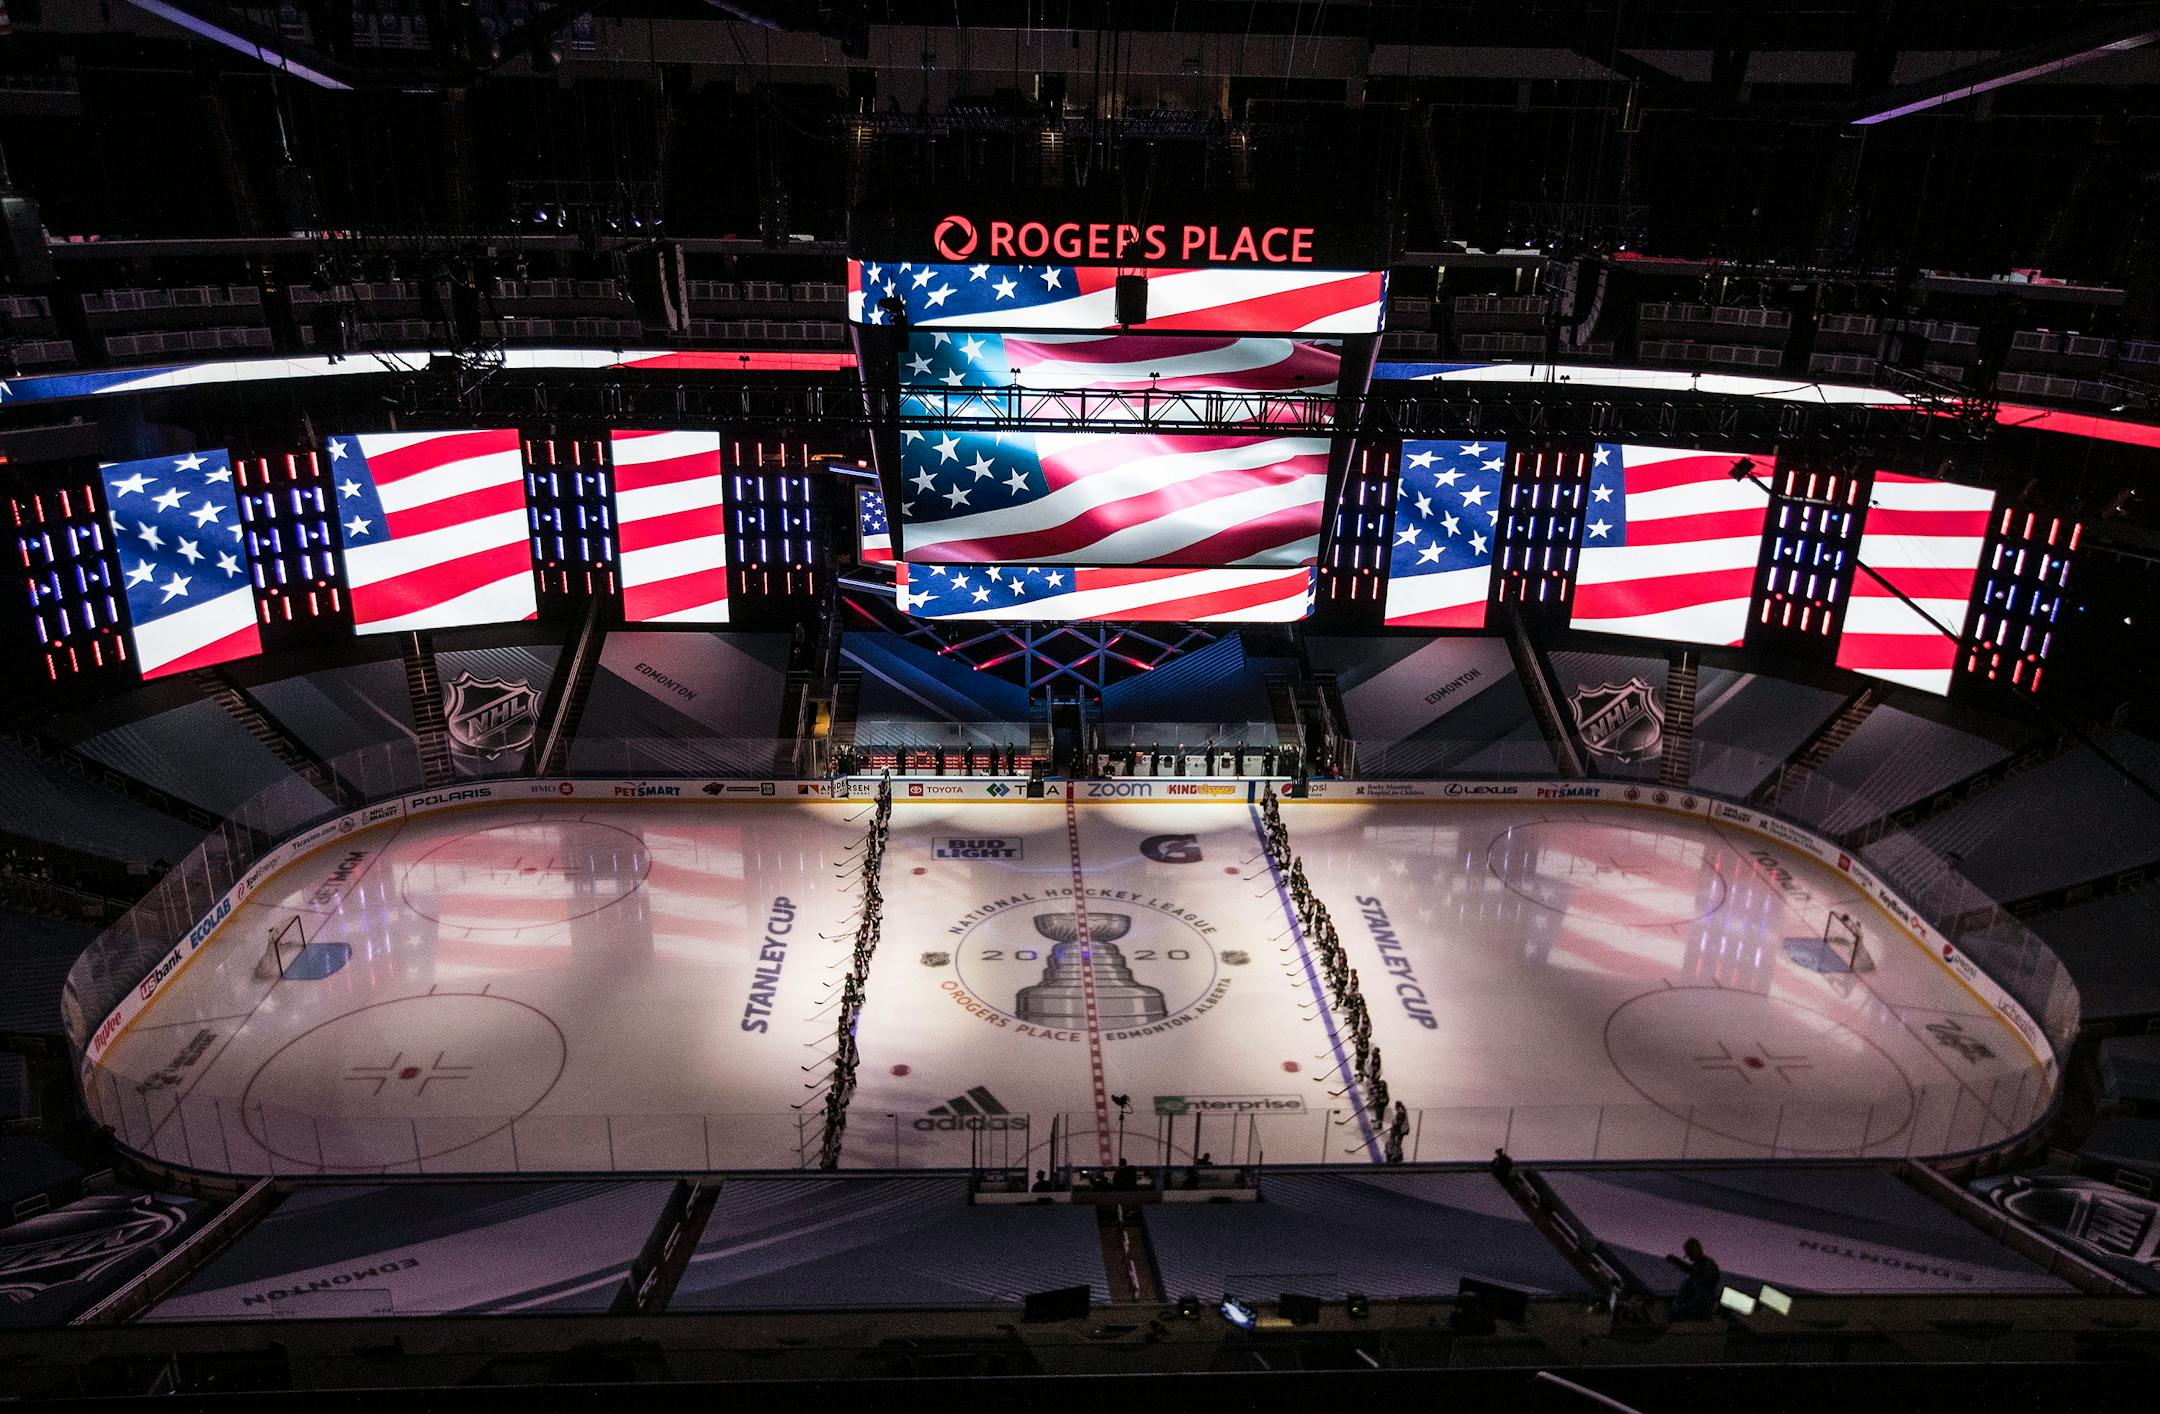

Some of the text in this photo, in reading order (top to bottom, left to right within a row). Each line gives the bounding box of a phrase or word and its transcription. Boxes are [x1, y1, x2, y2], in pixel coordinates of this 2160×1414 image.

[991, 222, 1315, 262] ROGERS PLACE
[634, 662, 697, 701] EDMONTON
[1424, 668, 1482, 705] EDMONTON
[467, 697, 527, 739] NHL
[1590, 698, 1641, 742] NHL
[412, 787, 492, 809] POLARIS
[531, 785, 556, 793] BMO
[614, 784, 681, 797] PETSMART
[927, 786, 963, 794] TOYOTA
[1015, 785, 1060, 796] TA
[1087, 781, 1152, 797] zoom
[1168, 784, 1197, 795] KING
[1464, 786, 1518, 795] LEXUS
[1536, 786, 1601, 798] PETSMART
[937, 849, 1017, 858] LIGHT
[949, 839, 1006, 848] BUD
[189, 898, 231, 949] ECOLAB
[949, 888, 1217, 935] NATIONAL HOCKEY LEAGUE
[741, 896, 797, 1034] STANLEY CUP
[1355, 895, 1439, 1030] STANLEY CUP
[1195, 977, 1232, 1015] ALBERTA
[950, 990, 1081, 1042] ROGERS PLACE
[914, 1115, 1028, 1131] adidas
[1799, 1242, 1974, 1283] EDMONTON
[243, 1258, 419, 1306] EDMONTON
